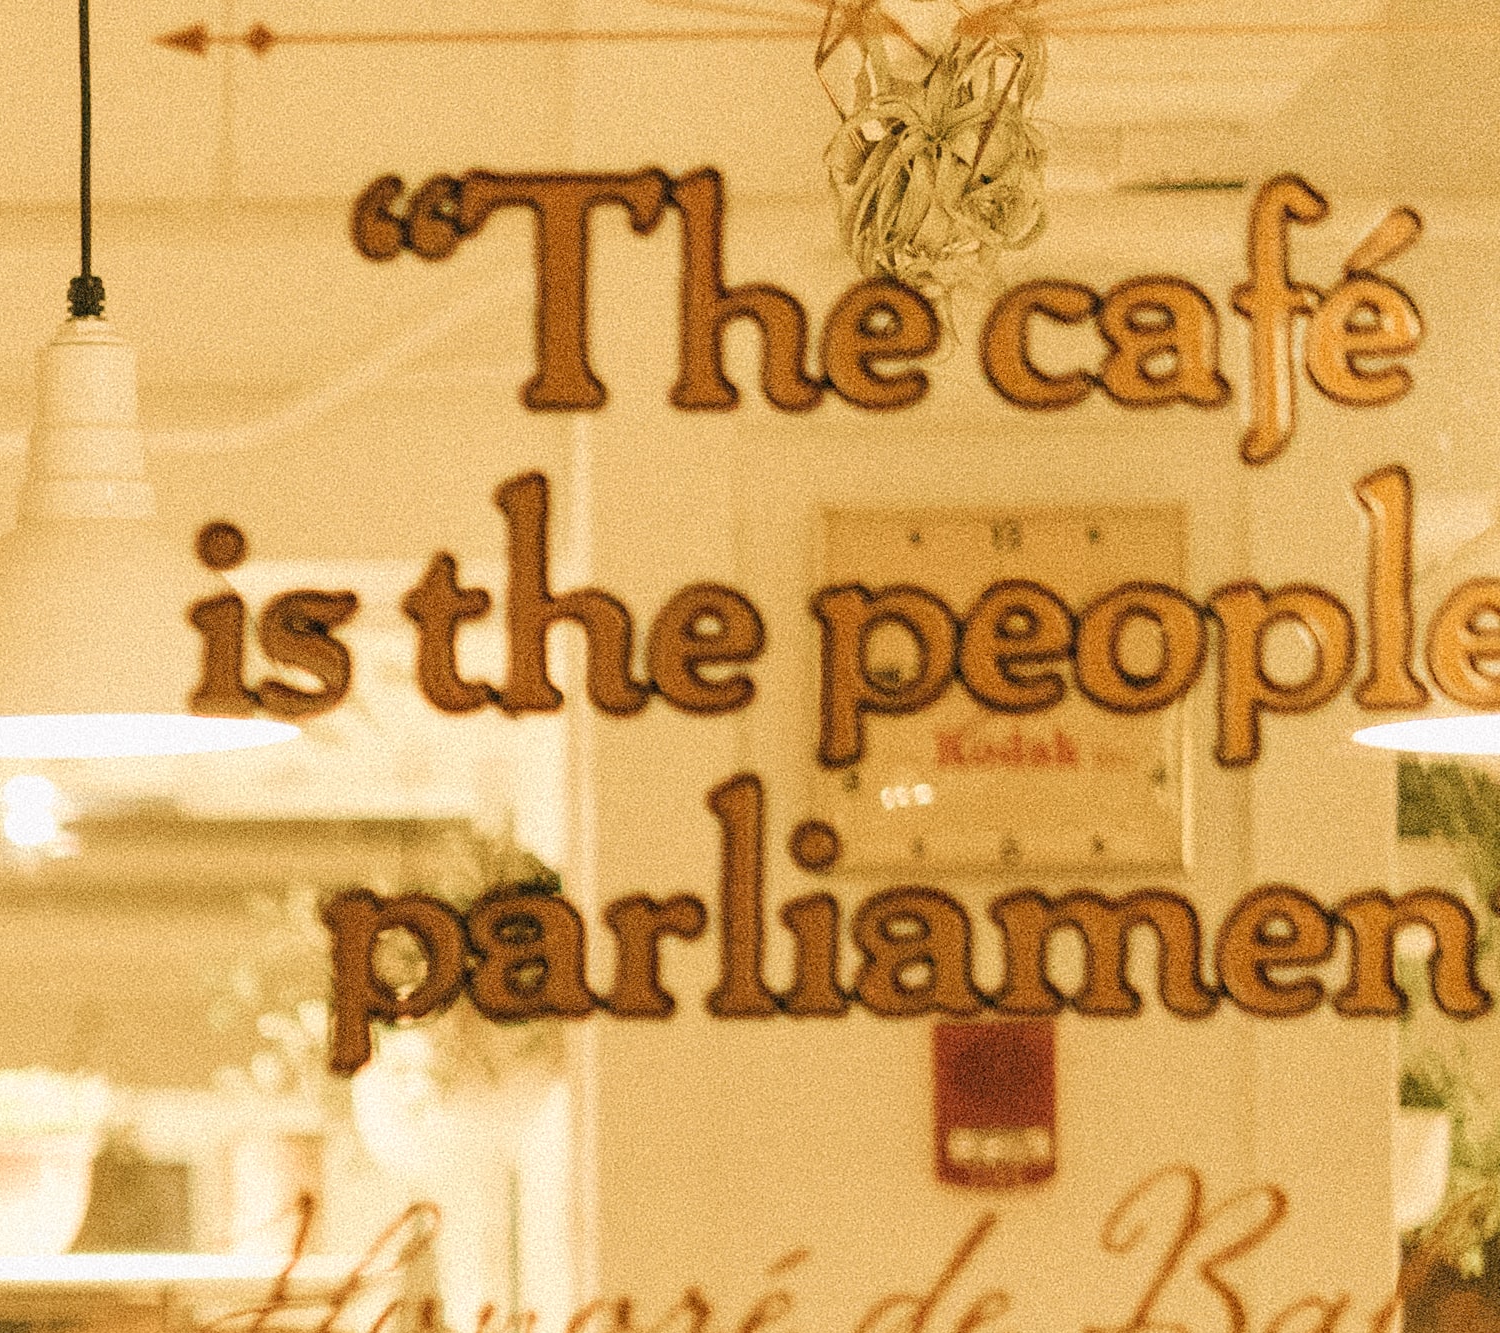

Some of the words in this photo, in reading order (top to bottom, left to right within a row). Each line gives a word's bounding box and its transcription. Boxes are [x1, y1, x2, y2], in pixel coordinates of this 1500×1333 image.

[980, 174, 1426, 464] café
[185, 520, 360, 716] is
[401, 471, 766, 716] the
[810, 464, 1500, 766] people
[937, 727, 1078, 768] Kodak
[319, 773, 1500, 1074] parliamen
